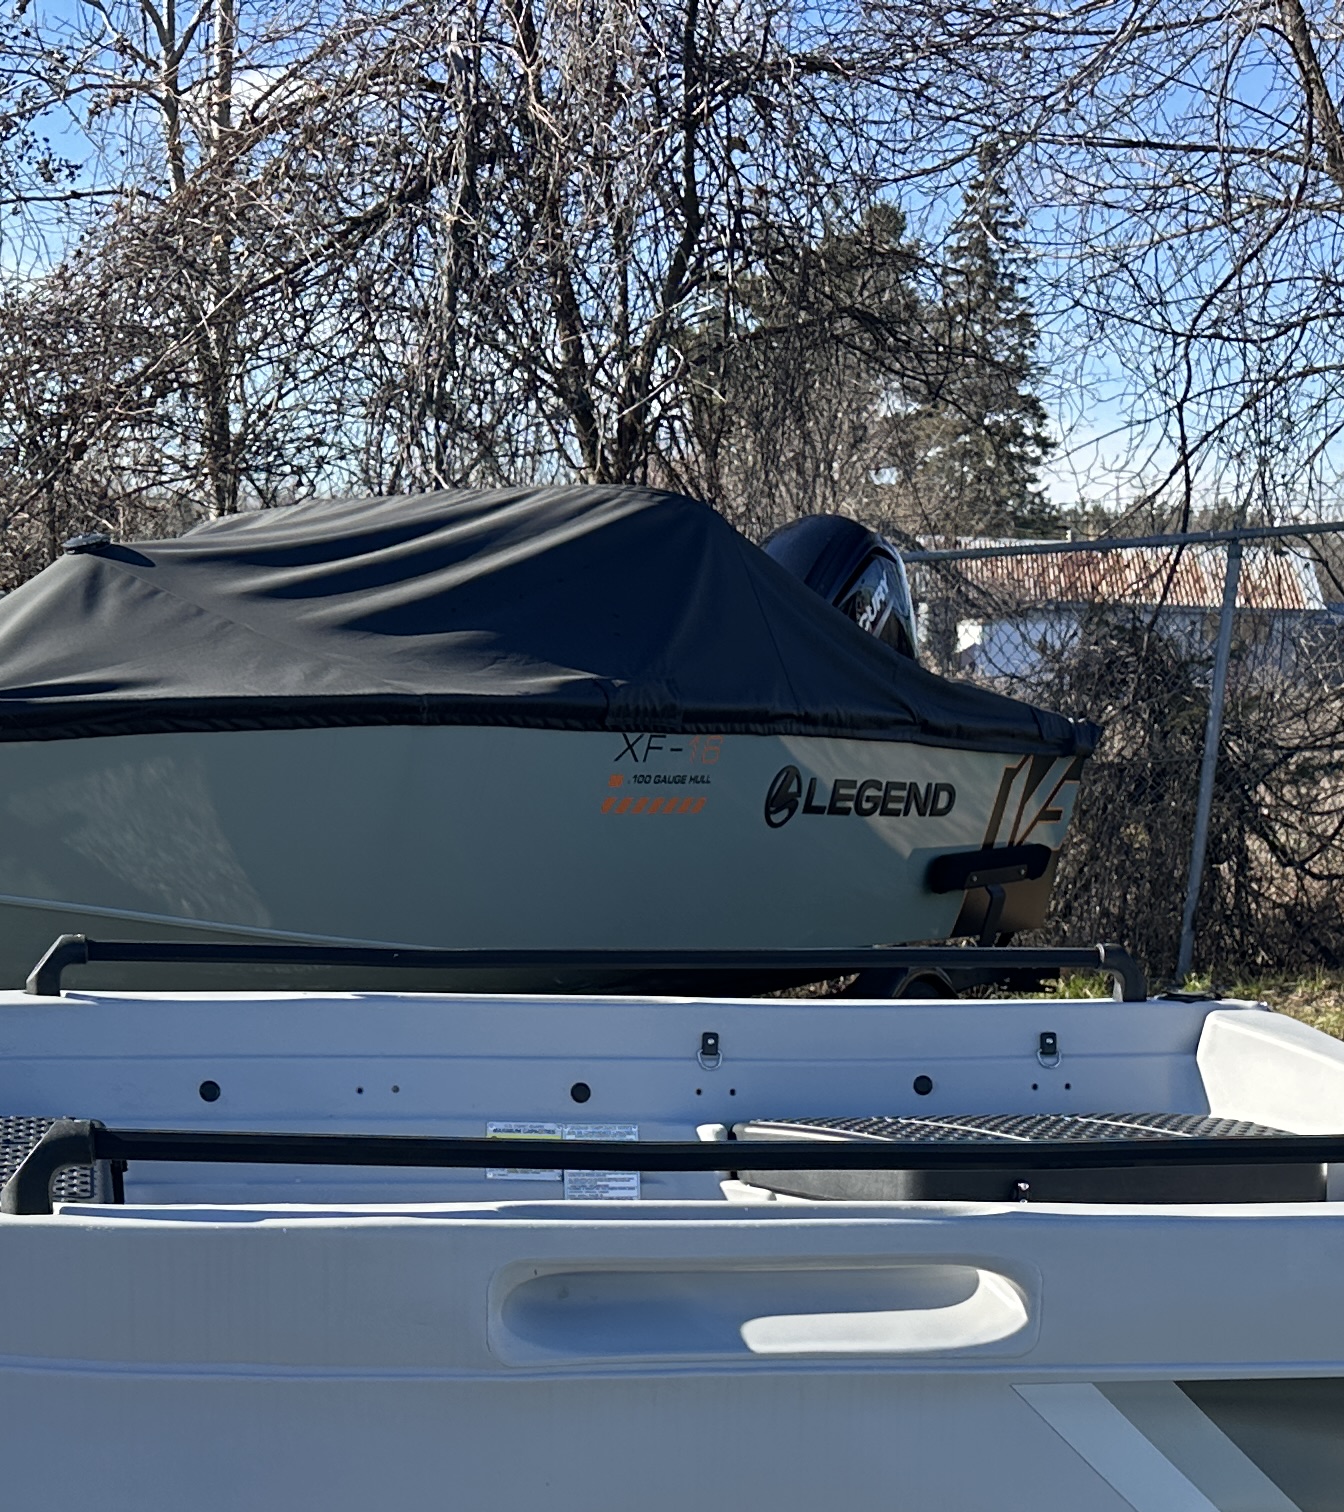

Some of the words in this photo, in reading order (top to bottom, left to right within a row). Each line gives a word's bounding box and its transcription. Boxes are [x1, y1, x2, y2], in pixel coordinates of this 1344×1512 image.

[653, 774, 688, 785] GAUGE
[688, 774, 712, 785] HULL
[802, 777, 956, 818] LEGEND
